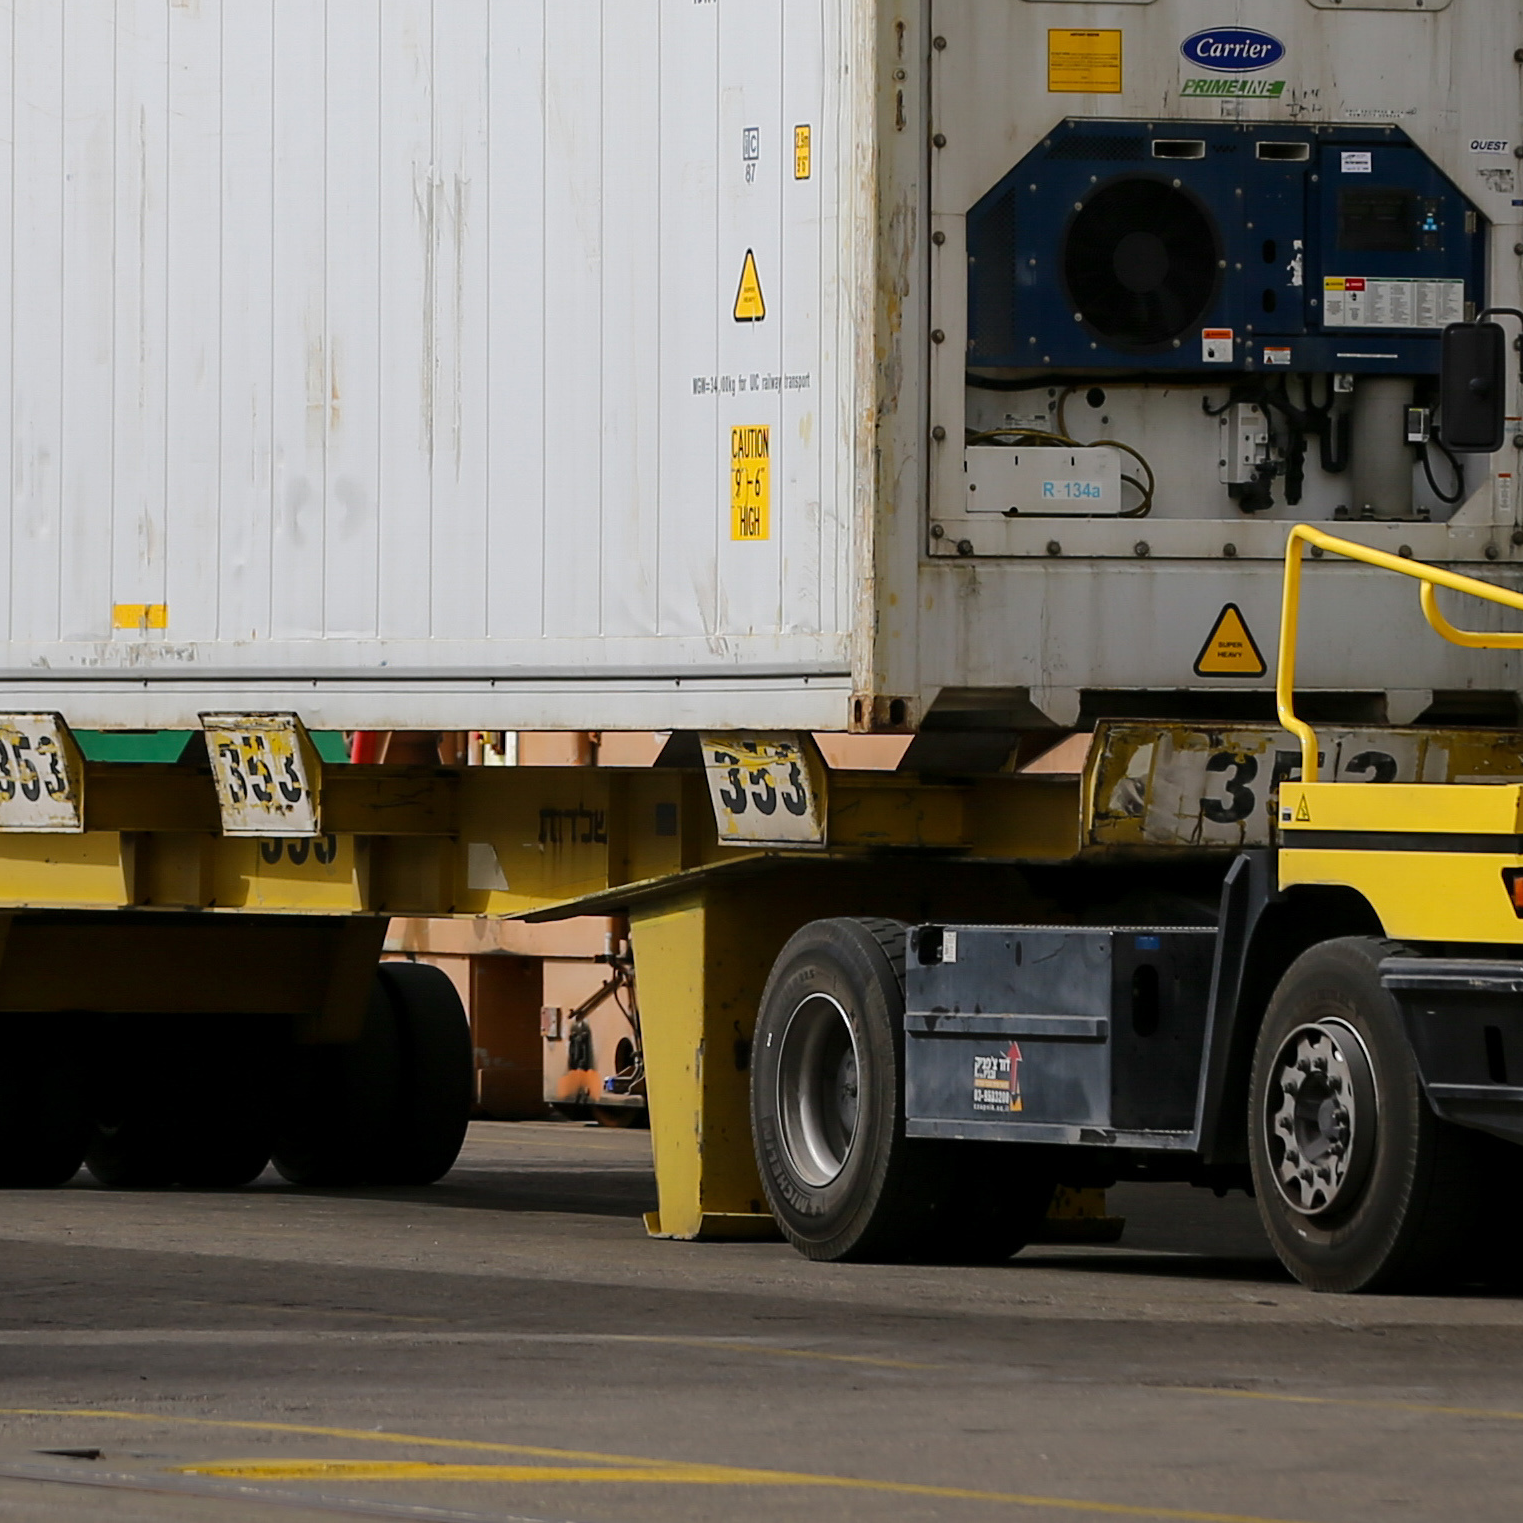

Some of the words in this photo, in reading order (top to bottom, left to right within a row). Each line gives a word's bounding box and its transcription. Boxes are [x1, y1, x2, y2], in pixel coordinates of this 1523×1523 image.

[1196, 38, 1272, 59] Carrier
[1181, 79, 1275, 95] PRIMELINE
[1470, 140, 1508, 151] QUEST
[745, 163, 756, 183] 87
[731, 429, 769, 458] CAUTION
[740, 506, 760, 536] HIGH
[1217, 651, 1243, 659] HEAVY
[218, 736, 302, 803] 353
[715, 740, 807, 817] 353
